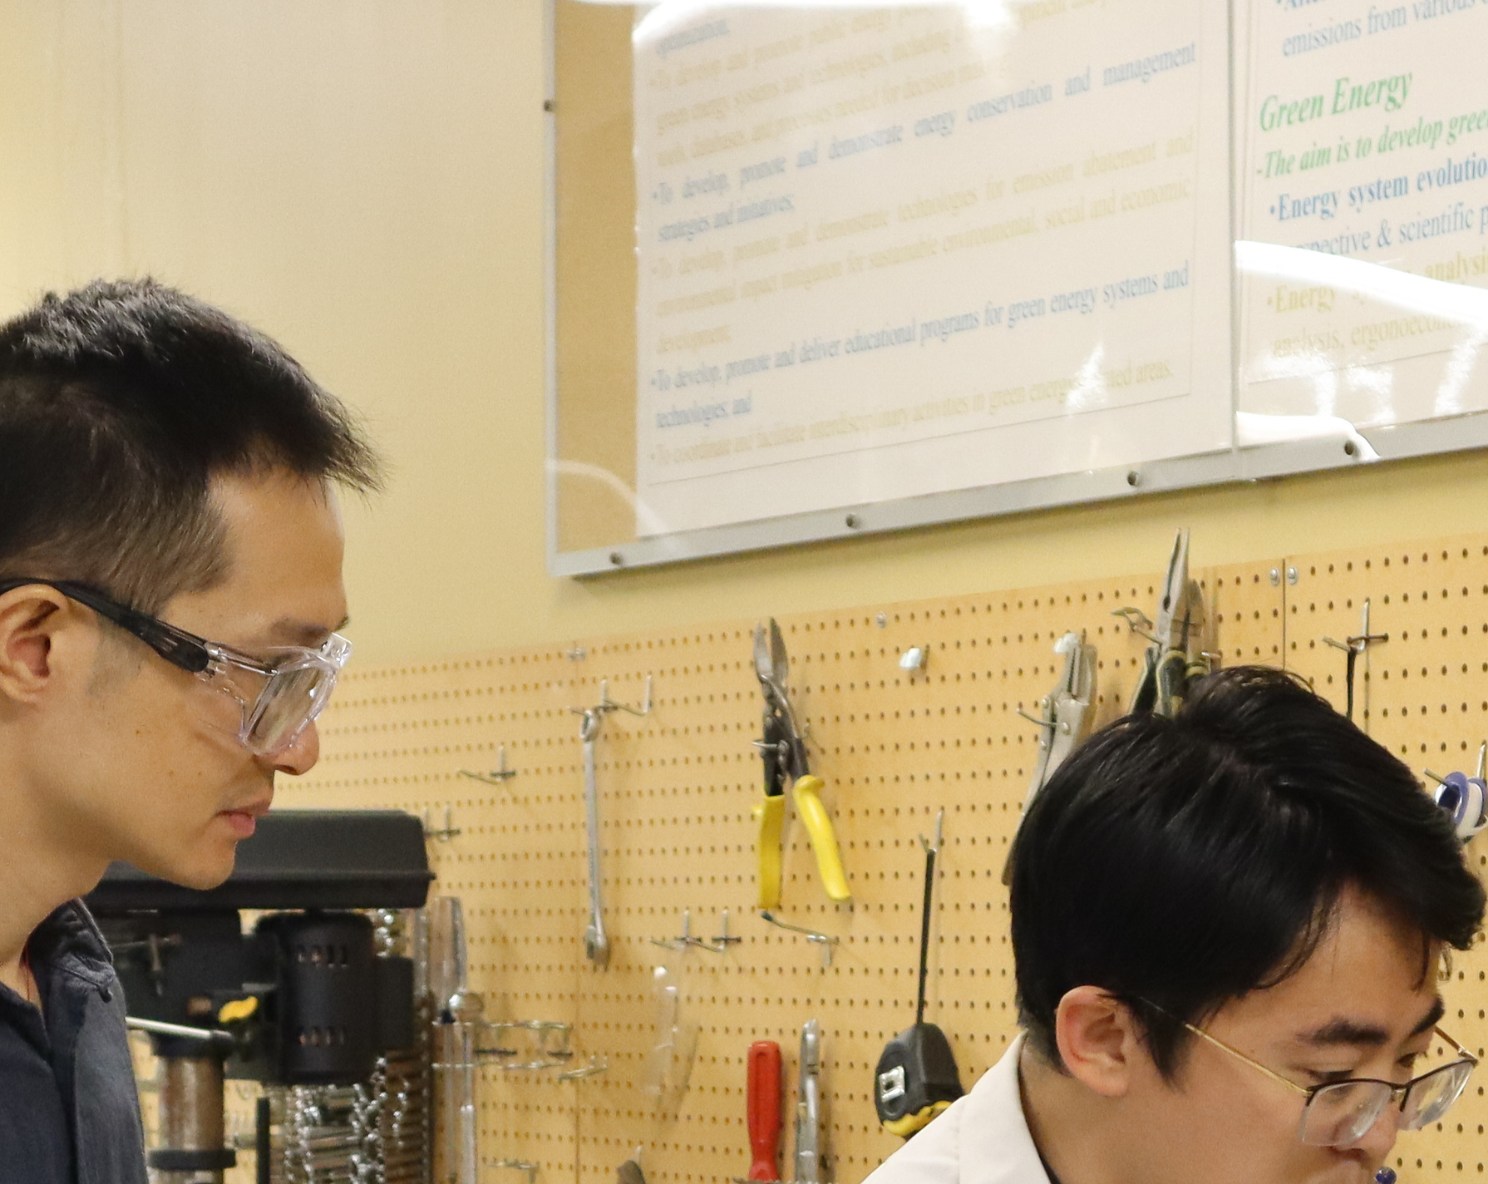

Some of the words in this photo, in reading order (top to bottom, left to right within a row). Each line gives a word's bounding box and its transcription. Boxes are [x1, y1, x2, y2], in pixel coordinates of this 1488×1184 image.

[1282, 19, 1360, 57] emissions
[1367, 5, 1406, 35] from
[914, 111, 956, 139] energy
[967, 80, 1052, 123] conservation
[1065, 66, 1090, 97] and
[1103, 42, 1196, 87] management
[1259, 94, 1324, 132] Green
[1330, 72, 1412, 116] Energy
[1299, 142, 1331, 172] aim
[1336, 136, 1350, 163] is
[1356, 137, 1372, 159] to
[1377, 116, 1444, 154] develop
[1347, 176, 1408, 213] system
[1376, 219, 1391, 249] &
[1398, 202, 1473, 244] scientific
[774, 342, 795, 369] and
[799, 337, 841, 365] deliver
[844, 318, 916, 356] educational
[920, 311, 980, 347] programs
[984, 300, 1004, 327] for
[1008, 298, 1045, 330] green
[1050, 287, 1096, 316] energy
[1102, 274, 1157, 310] systems
[1162, 260, 1189, 291] and
